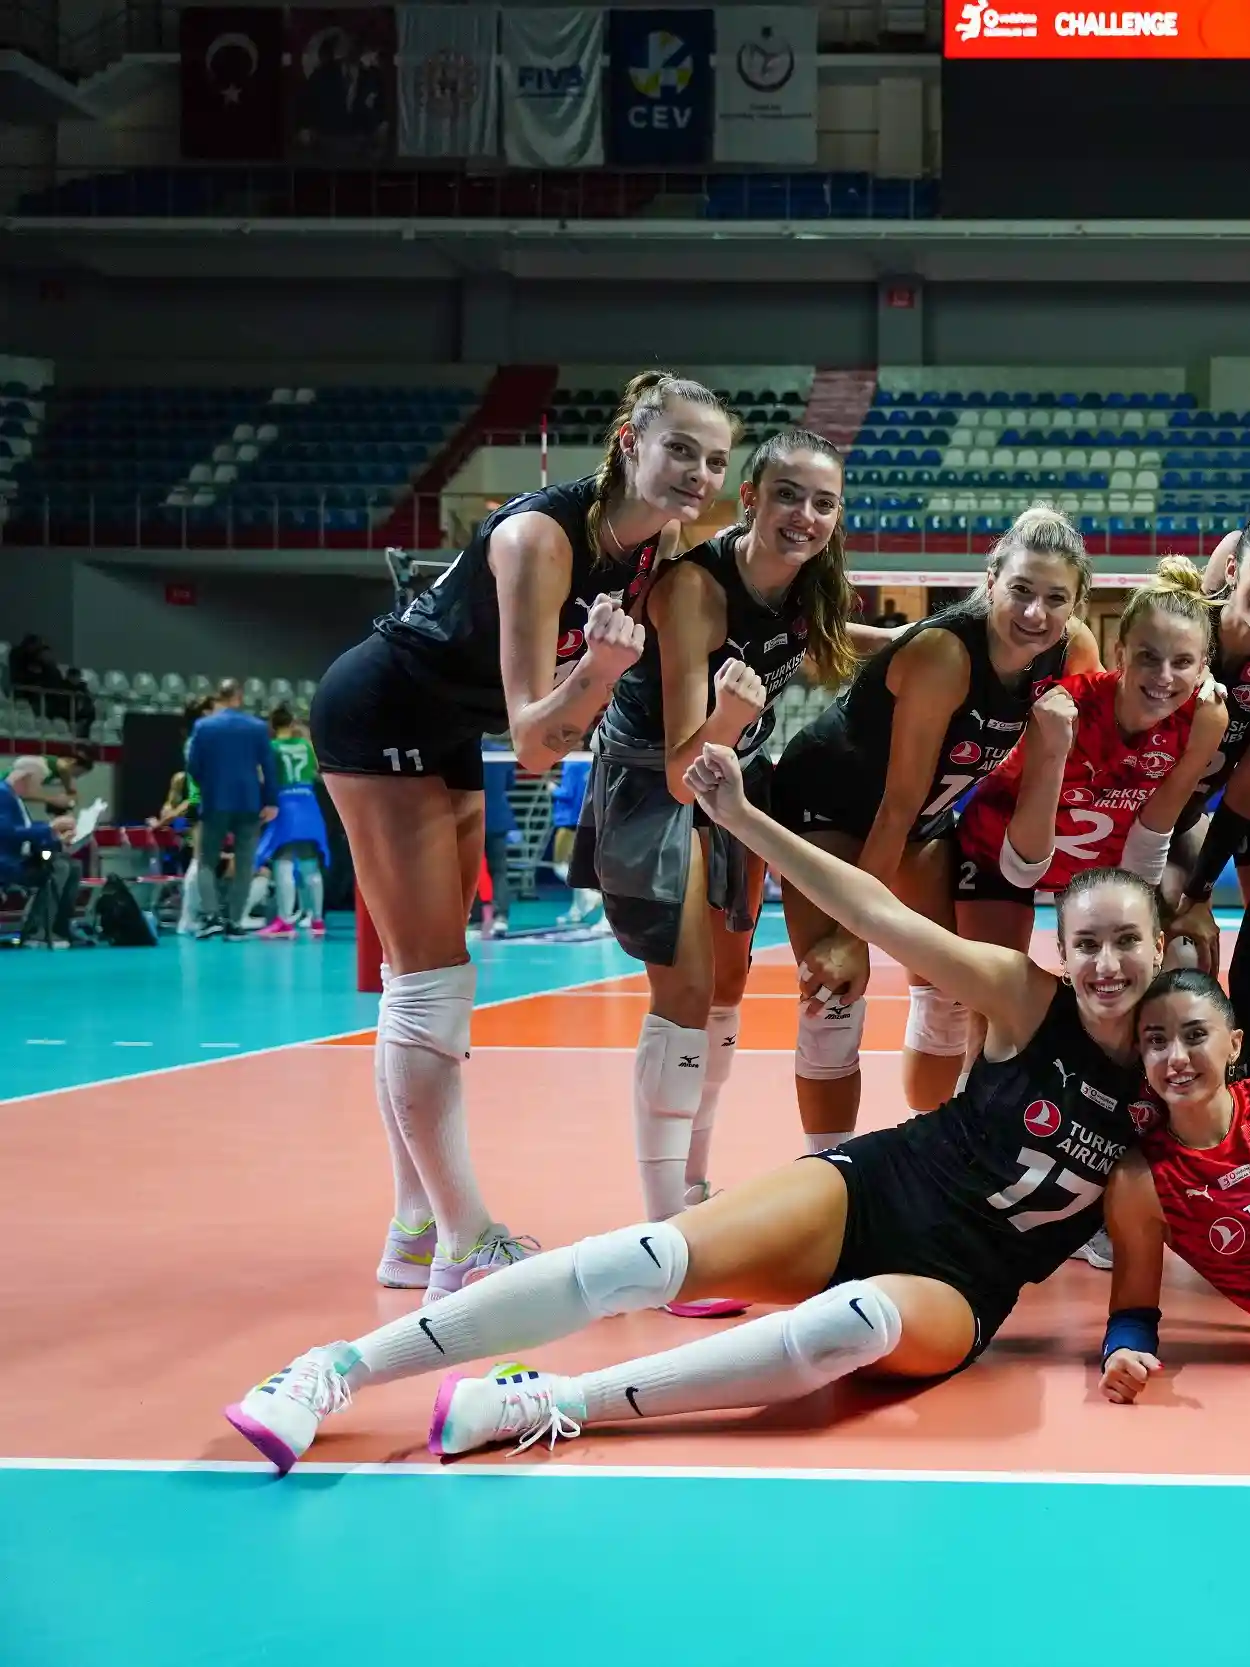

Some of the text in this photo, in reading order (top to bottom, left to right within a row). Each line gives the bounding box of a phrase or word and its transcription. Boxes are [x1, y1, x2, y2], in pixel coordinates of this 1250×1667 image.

[1054, 11, 1178, 36] CHALLENGE
[627, 104, 694, 129] CEV
[278, 743, 308, 784] 17
[383, 748, 423, 771] 11
[1055, 808, 1115, 860] 2
[958, 861, 978, 890] 2
[1056, 1138, 1116, 1175] AIRLIN
